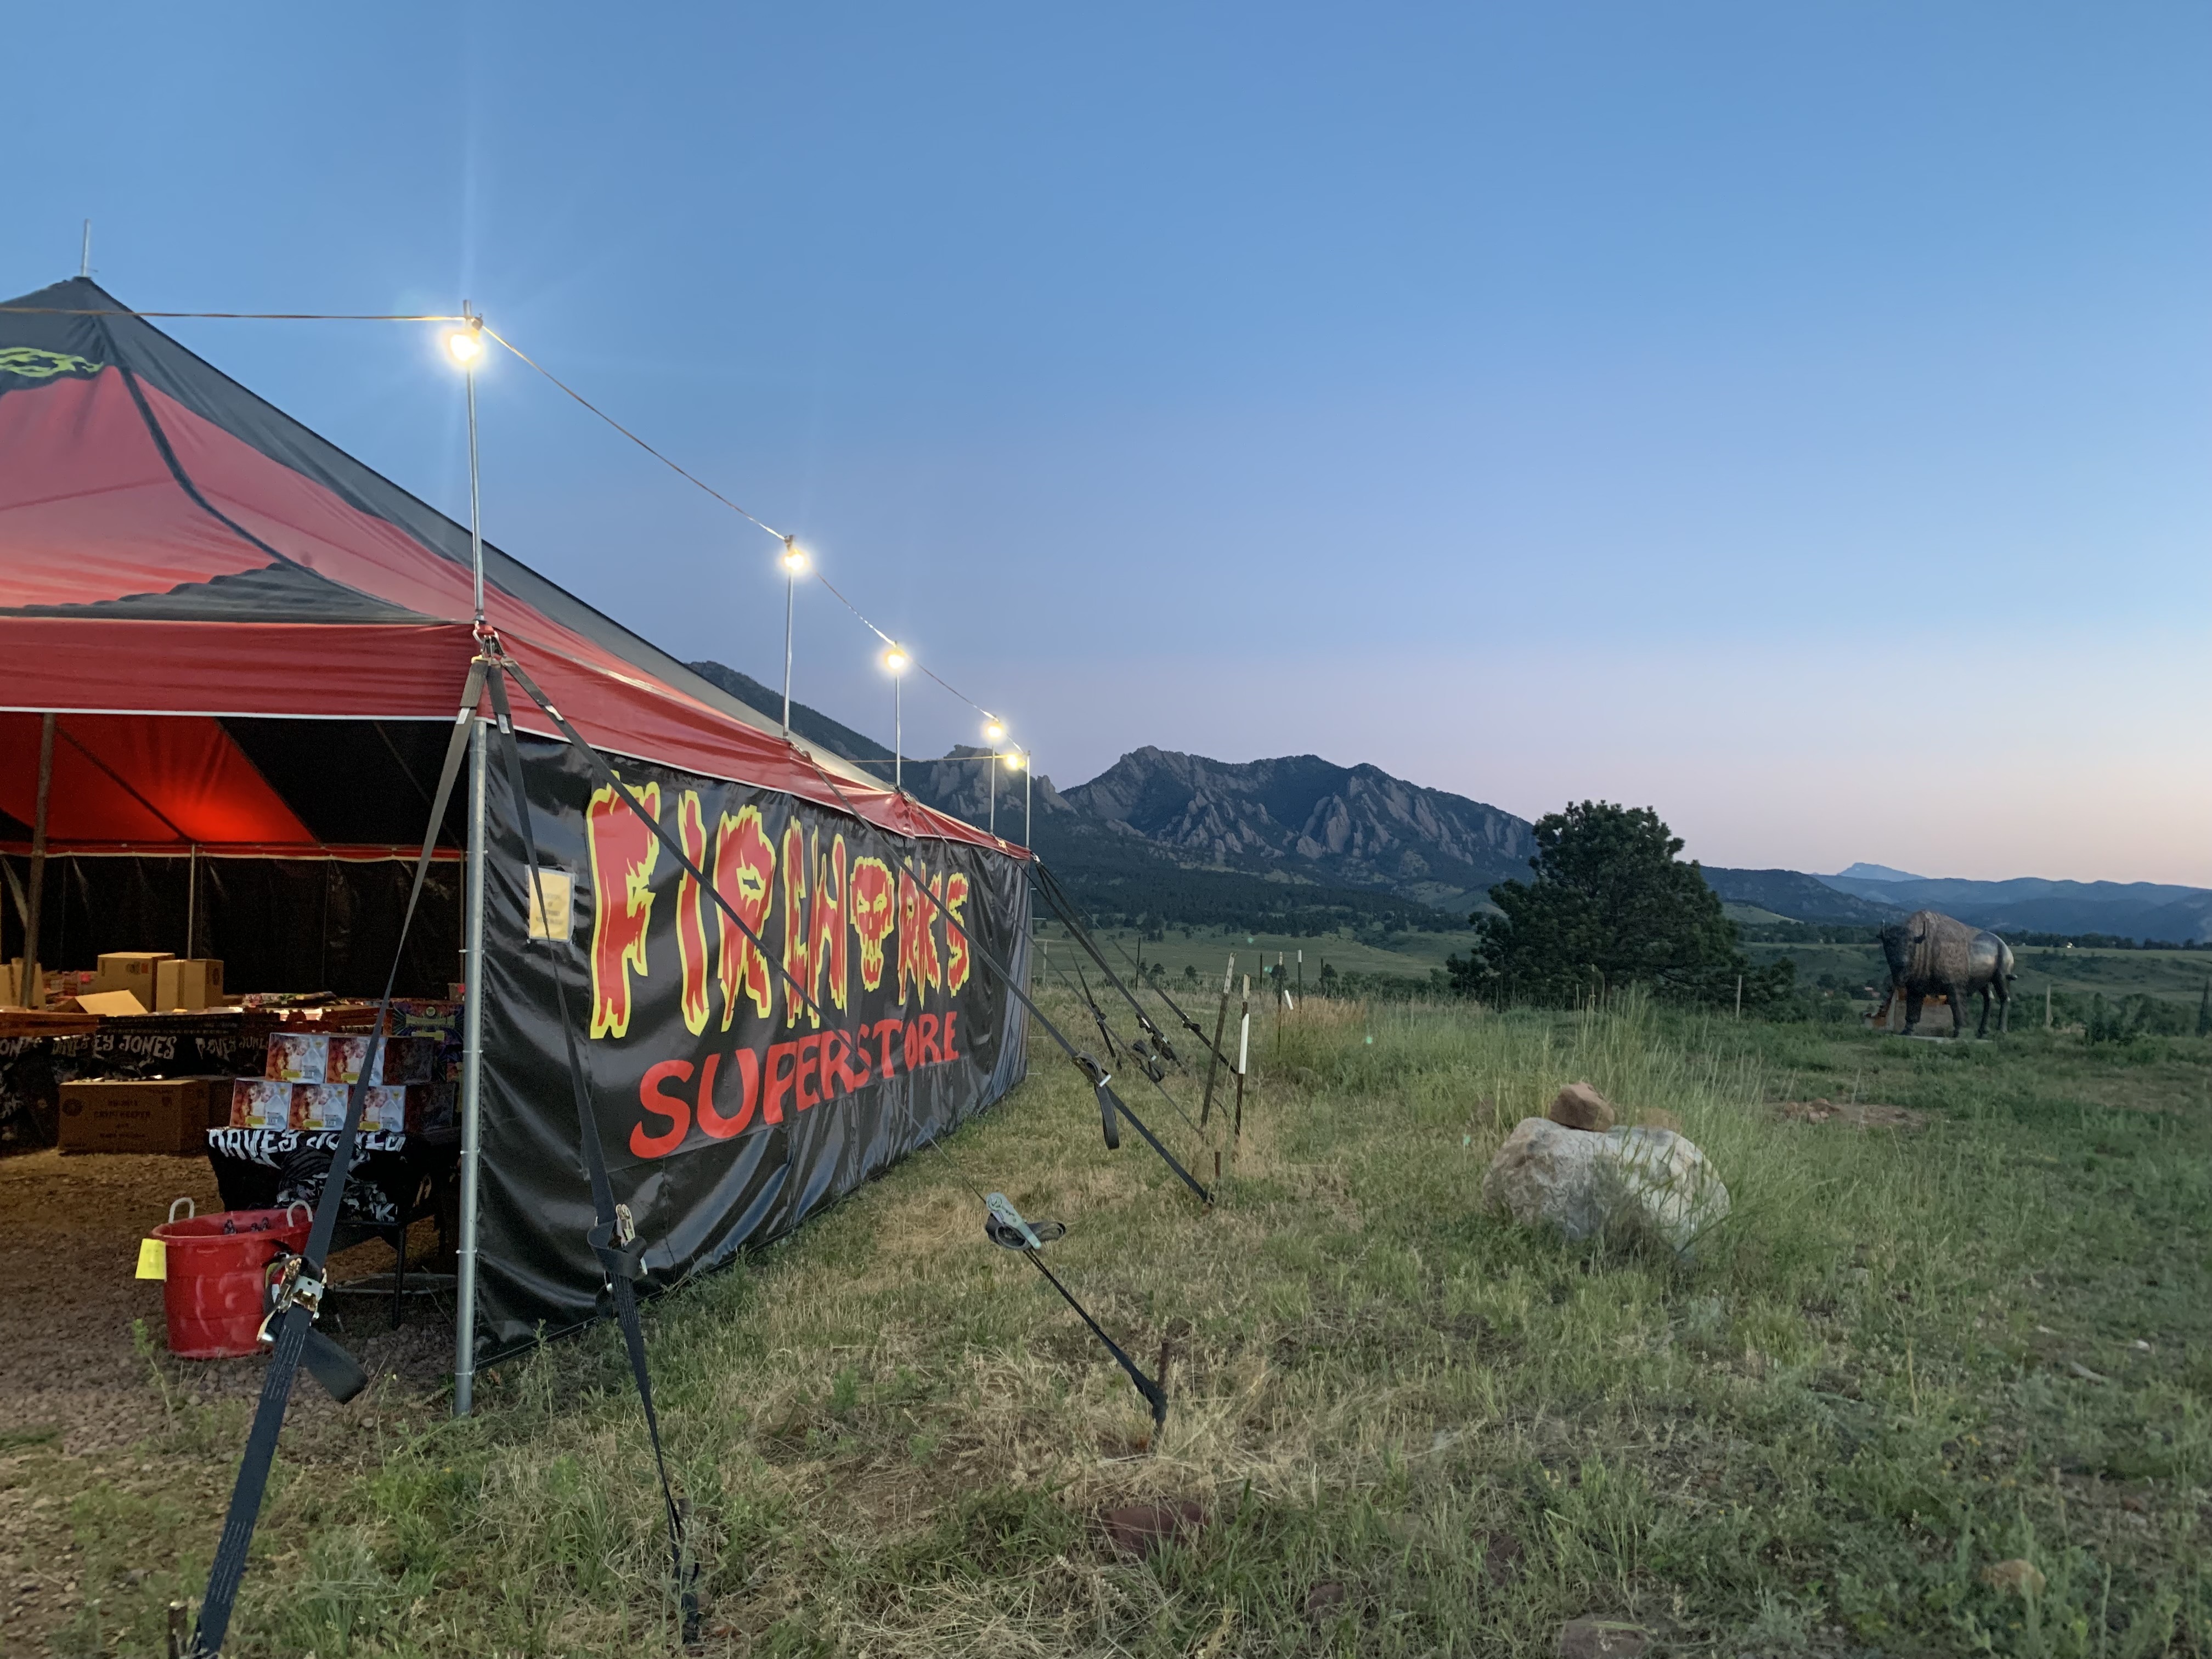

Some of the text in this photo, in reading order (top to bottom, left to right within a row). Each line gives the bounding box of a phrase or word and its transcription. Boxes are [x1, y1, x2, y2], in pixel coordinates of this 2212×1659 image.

[587, 771, 970, 1039] FIREWORKS
[119, 1035, 177, 1060] JONES
[629, 1012, 958, 1158] SUPERSTORE
